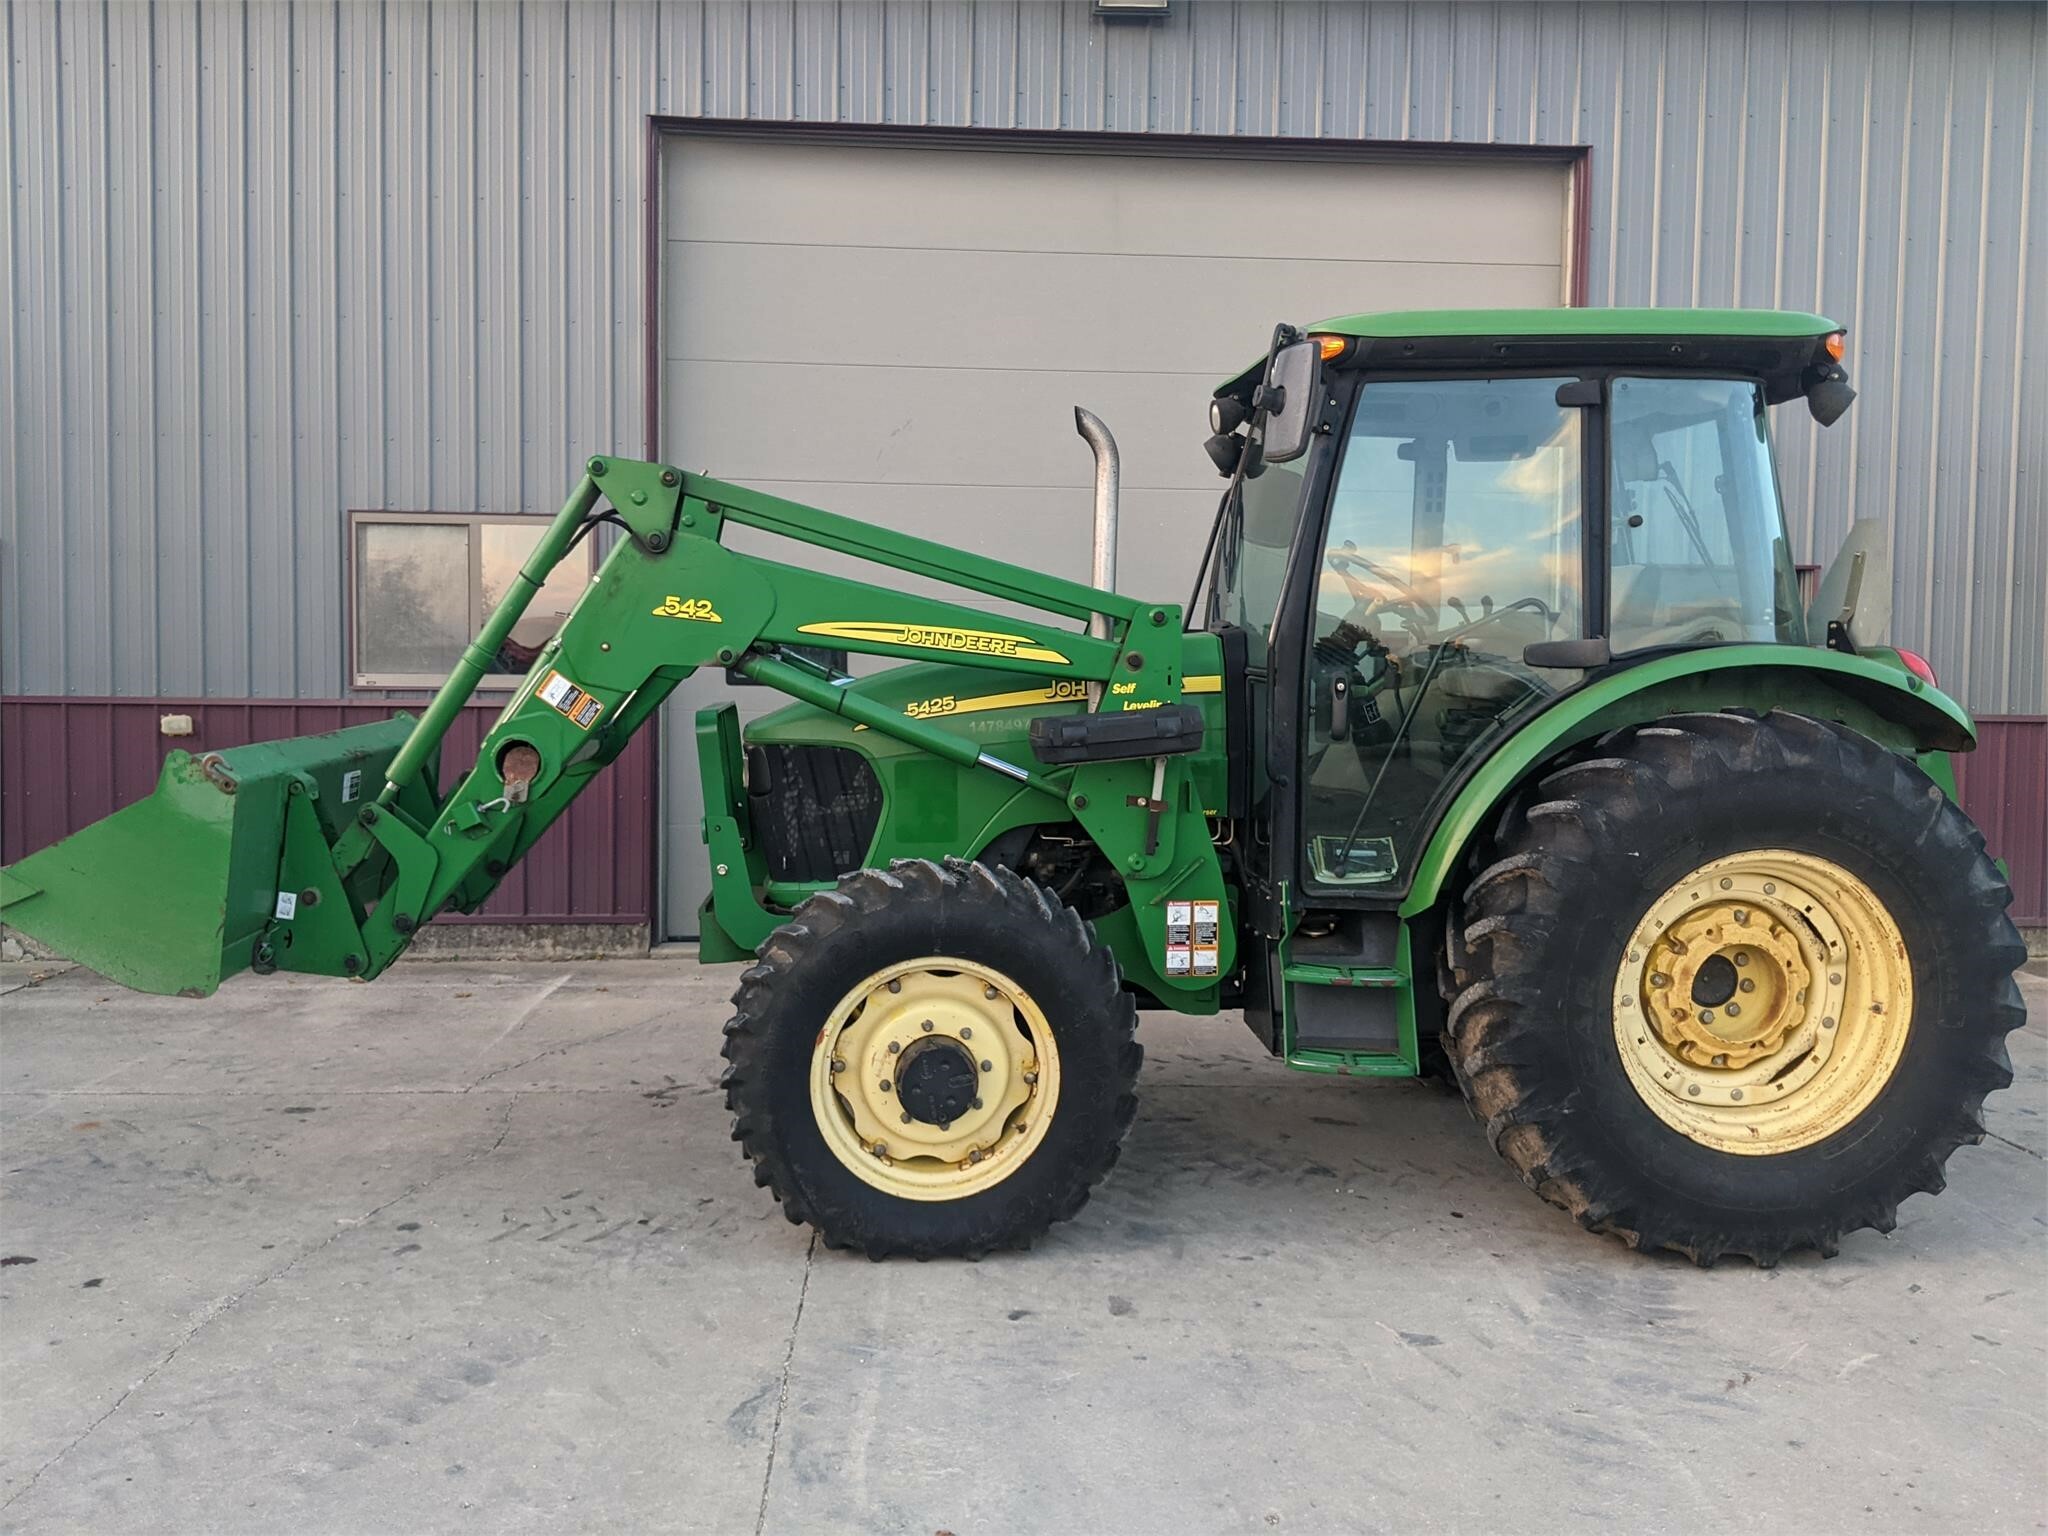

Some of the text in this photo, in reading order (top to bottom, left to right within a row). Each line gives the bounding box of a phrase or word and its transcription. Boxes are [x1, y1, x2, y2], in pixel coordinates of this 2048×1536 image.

[664, 595, 712, 619] 542
[897, 626, 1017, 655] JOHN DEERE
[1045, 679, 1088, 698] JOH
[1112, 682, 1137, 695] Self
[907, 695, 957, 717] 5425
